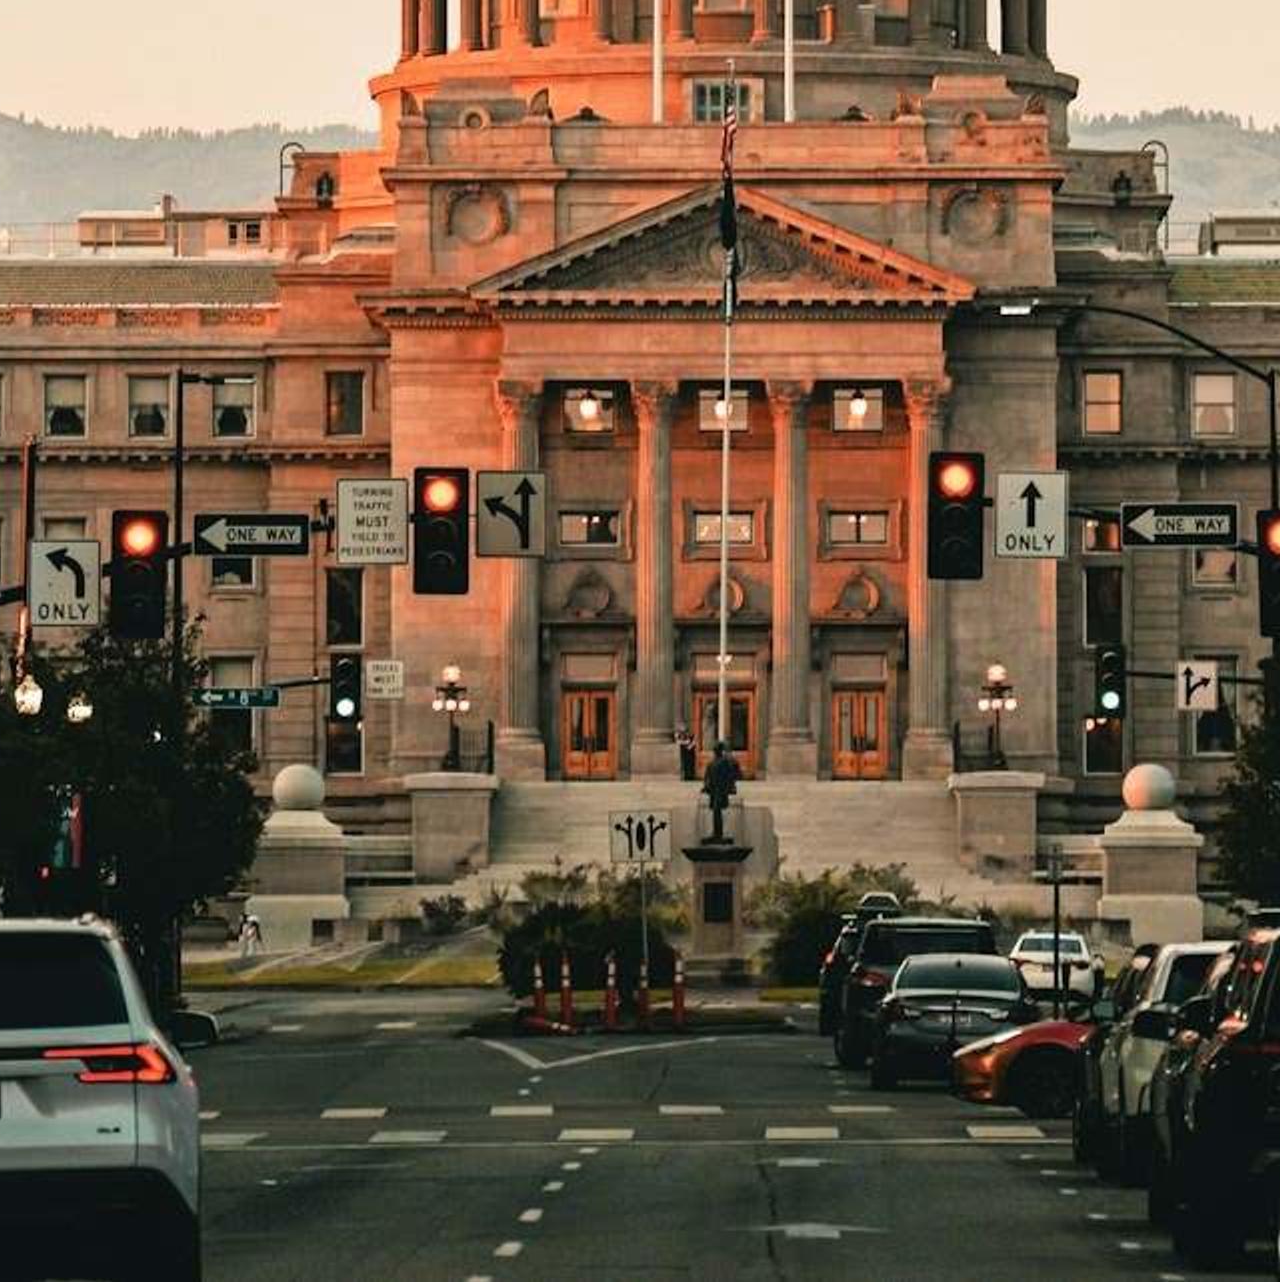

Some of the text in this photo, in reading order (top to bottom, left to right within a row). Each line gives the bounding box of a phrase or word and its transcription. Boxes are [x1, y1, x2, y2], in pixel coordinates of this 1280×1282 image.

[354, 501, 392, 511] TRAFFIC
[356, 516, 388, 527] MUST
[1155, 516, 1226, 533] ONE WAY
[226, 525, 297, 542] ONE WAY
[1005, 532, 1056, 552] ONLY
[340, 546, 404, 557] PEDESTRIANS
[38, 602, 91, 622] ONLY
